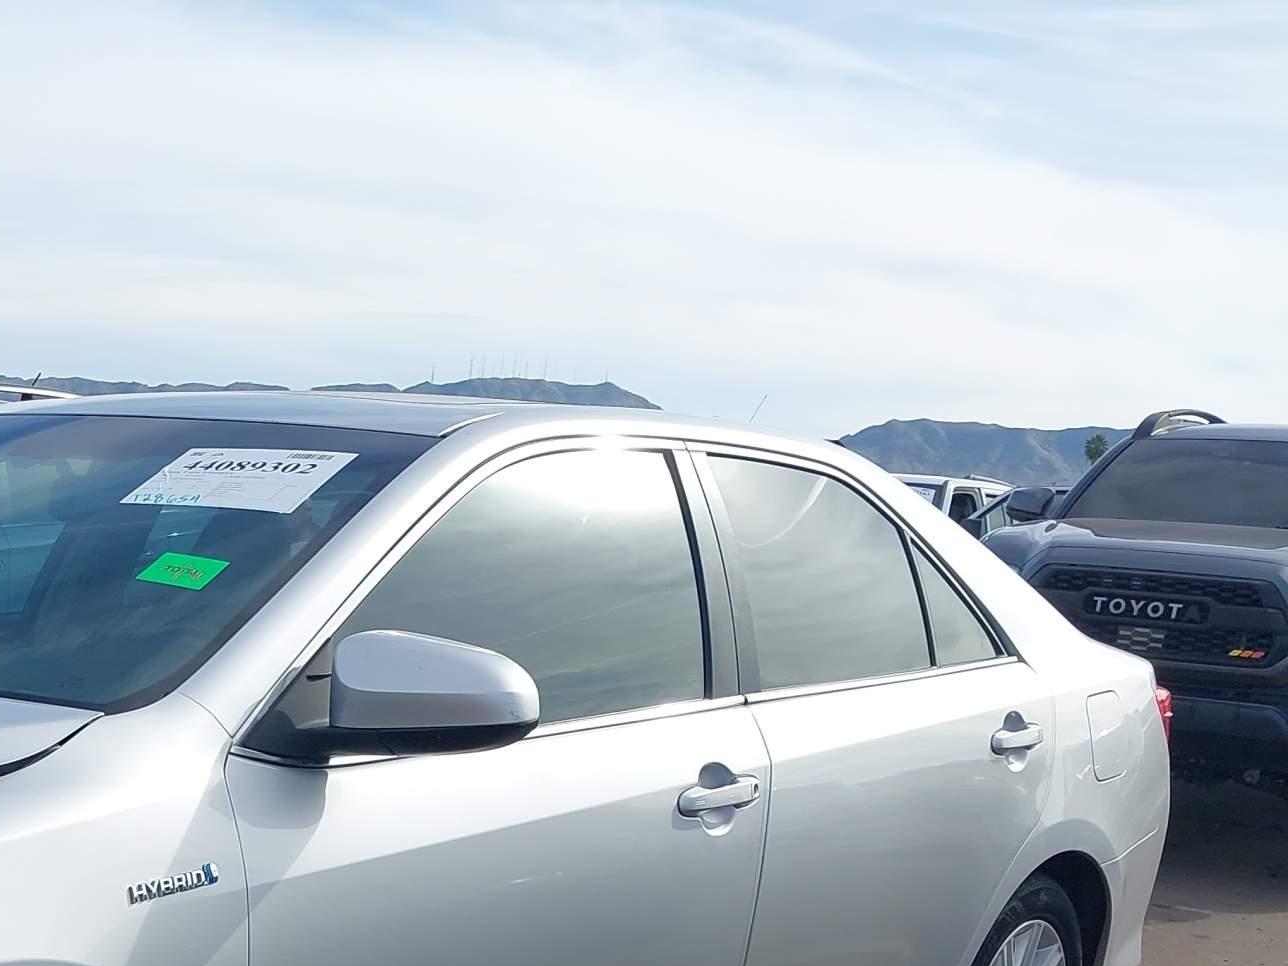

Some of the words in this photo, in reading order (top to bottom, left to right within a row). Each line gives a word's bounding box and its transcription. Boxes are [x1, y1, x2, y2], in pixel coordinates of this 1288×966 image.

[183, 460, 318, 474] 44089302
[1093, 596, 1201, 623] TOYOTA
[127, 870, 206, 906] HYBRID
